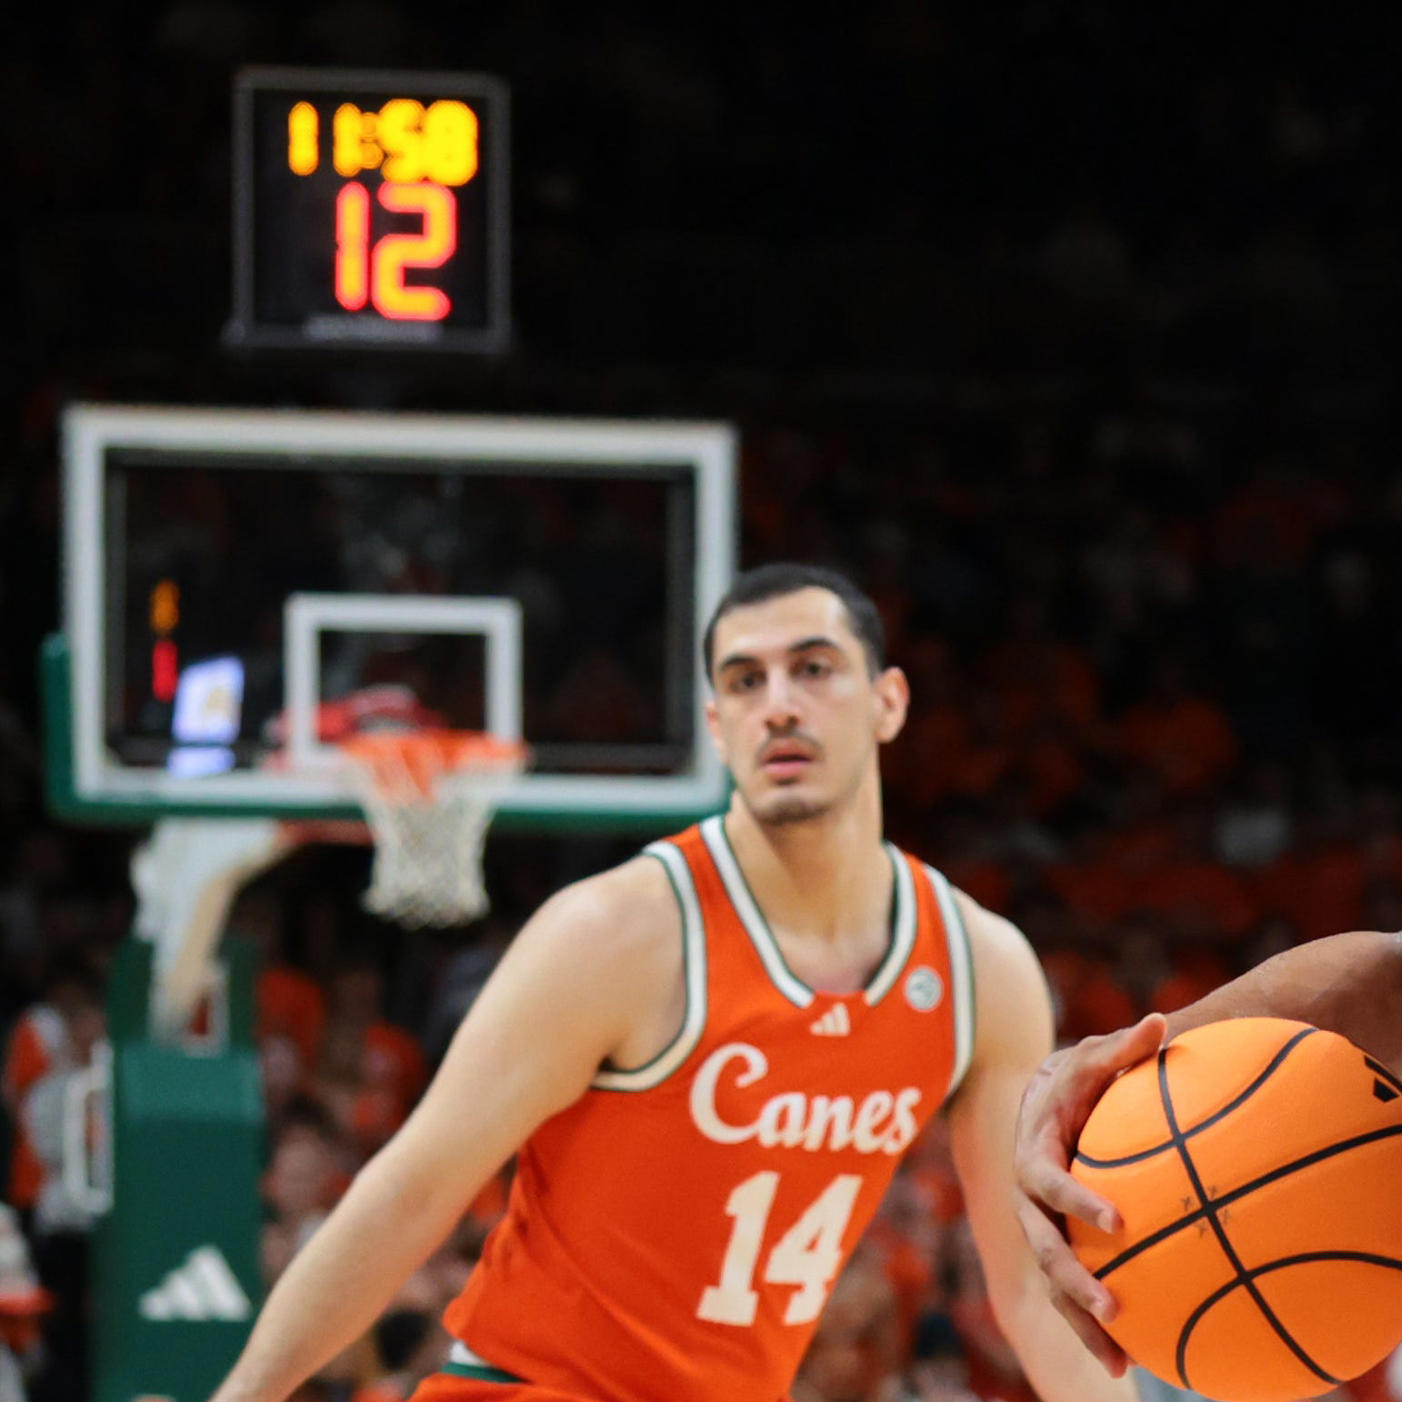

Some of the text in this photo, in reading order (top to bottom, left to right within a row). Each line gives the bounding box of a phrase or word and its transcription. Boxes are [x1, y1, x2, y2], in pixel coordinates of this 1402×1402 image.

[335, 181, 456, 320] 12
[689, 1042, 921, 1156] Canes
[696, 1170, 863, 1327] 14
